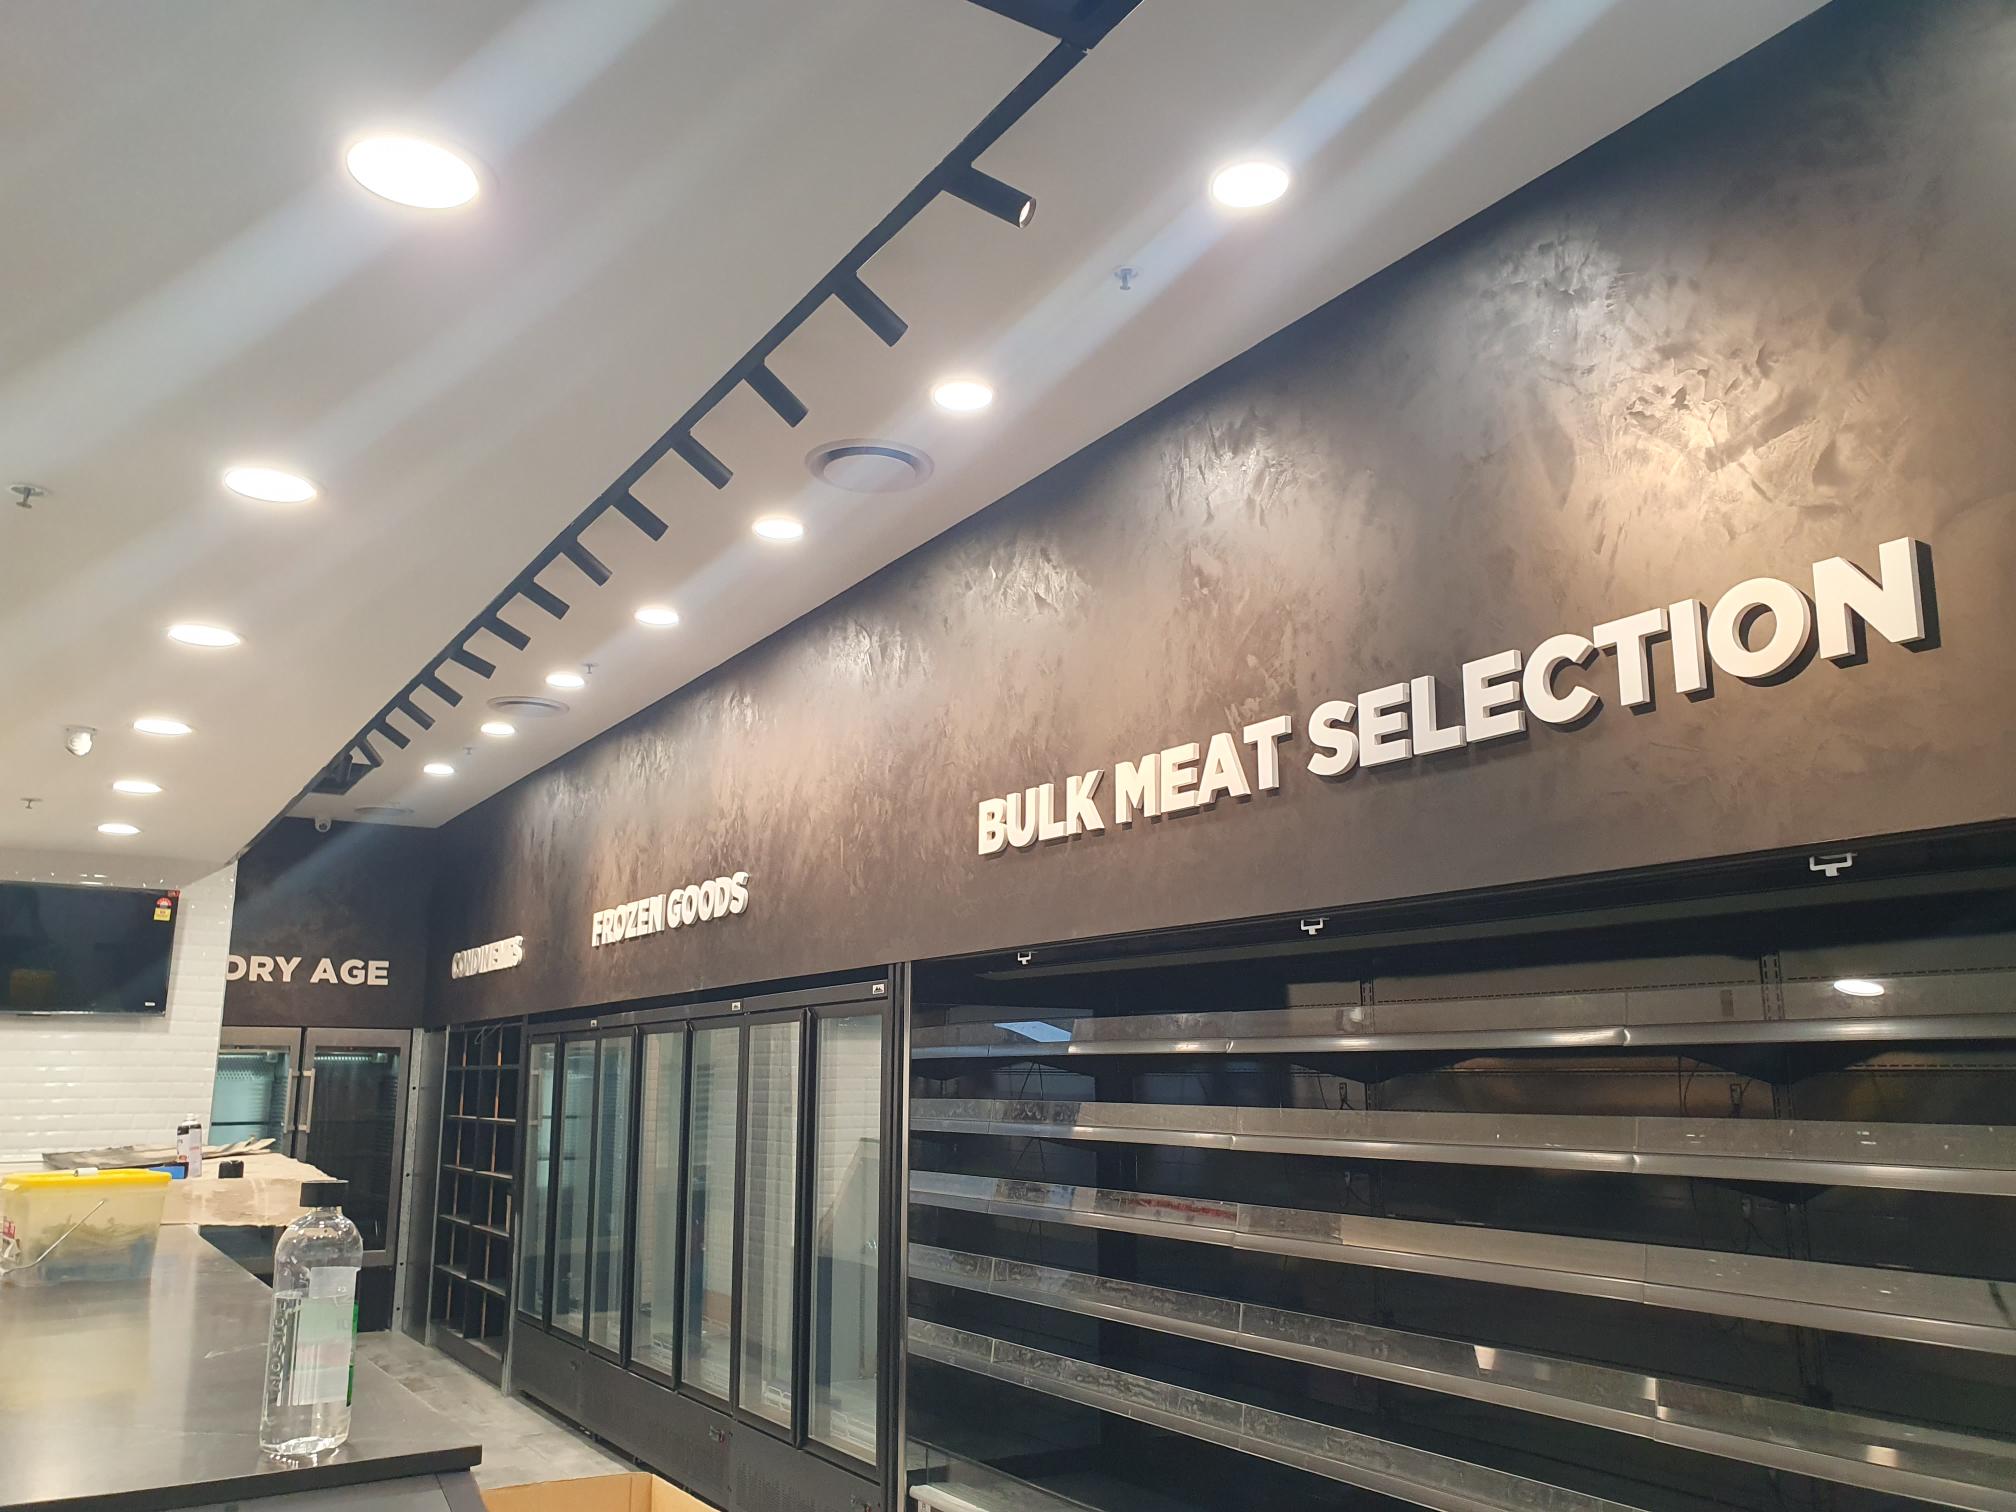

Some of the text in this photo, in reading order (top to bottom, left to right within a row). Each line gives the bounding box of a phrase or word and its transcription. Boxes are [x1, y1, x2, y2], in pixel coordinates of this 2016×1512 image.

[978, 536, 1927, 856] BULK MEAT SELECTION
[591, 871, 750, 947] FROZEN GOODS
[226, 954, 390, 986] DRY AGE
